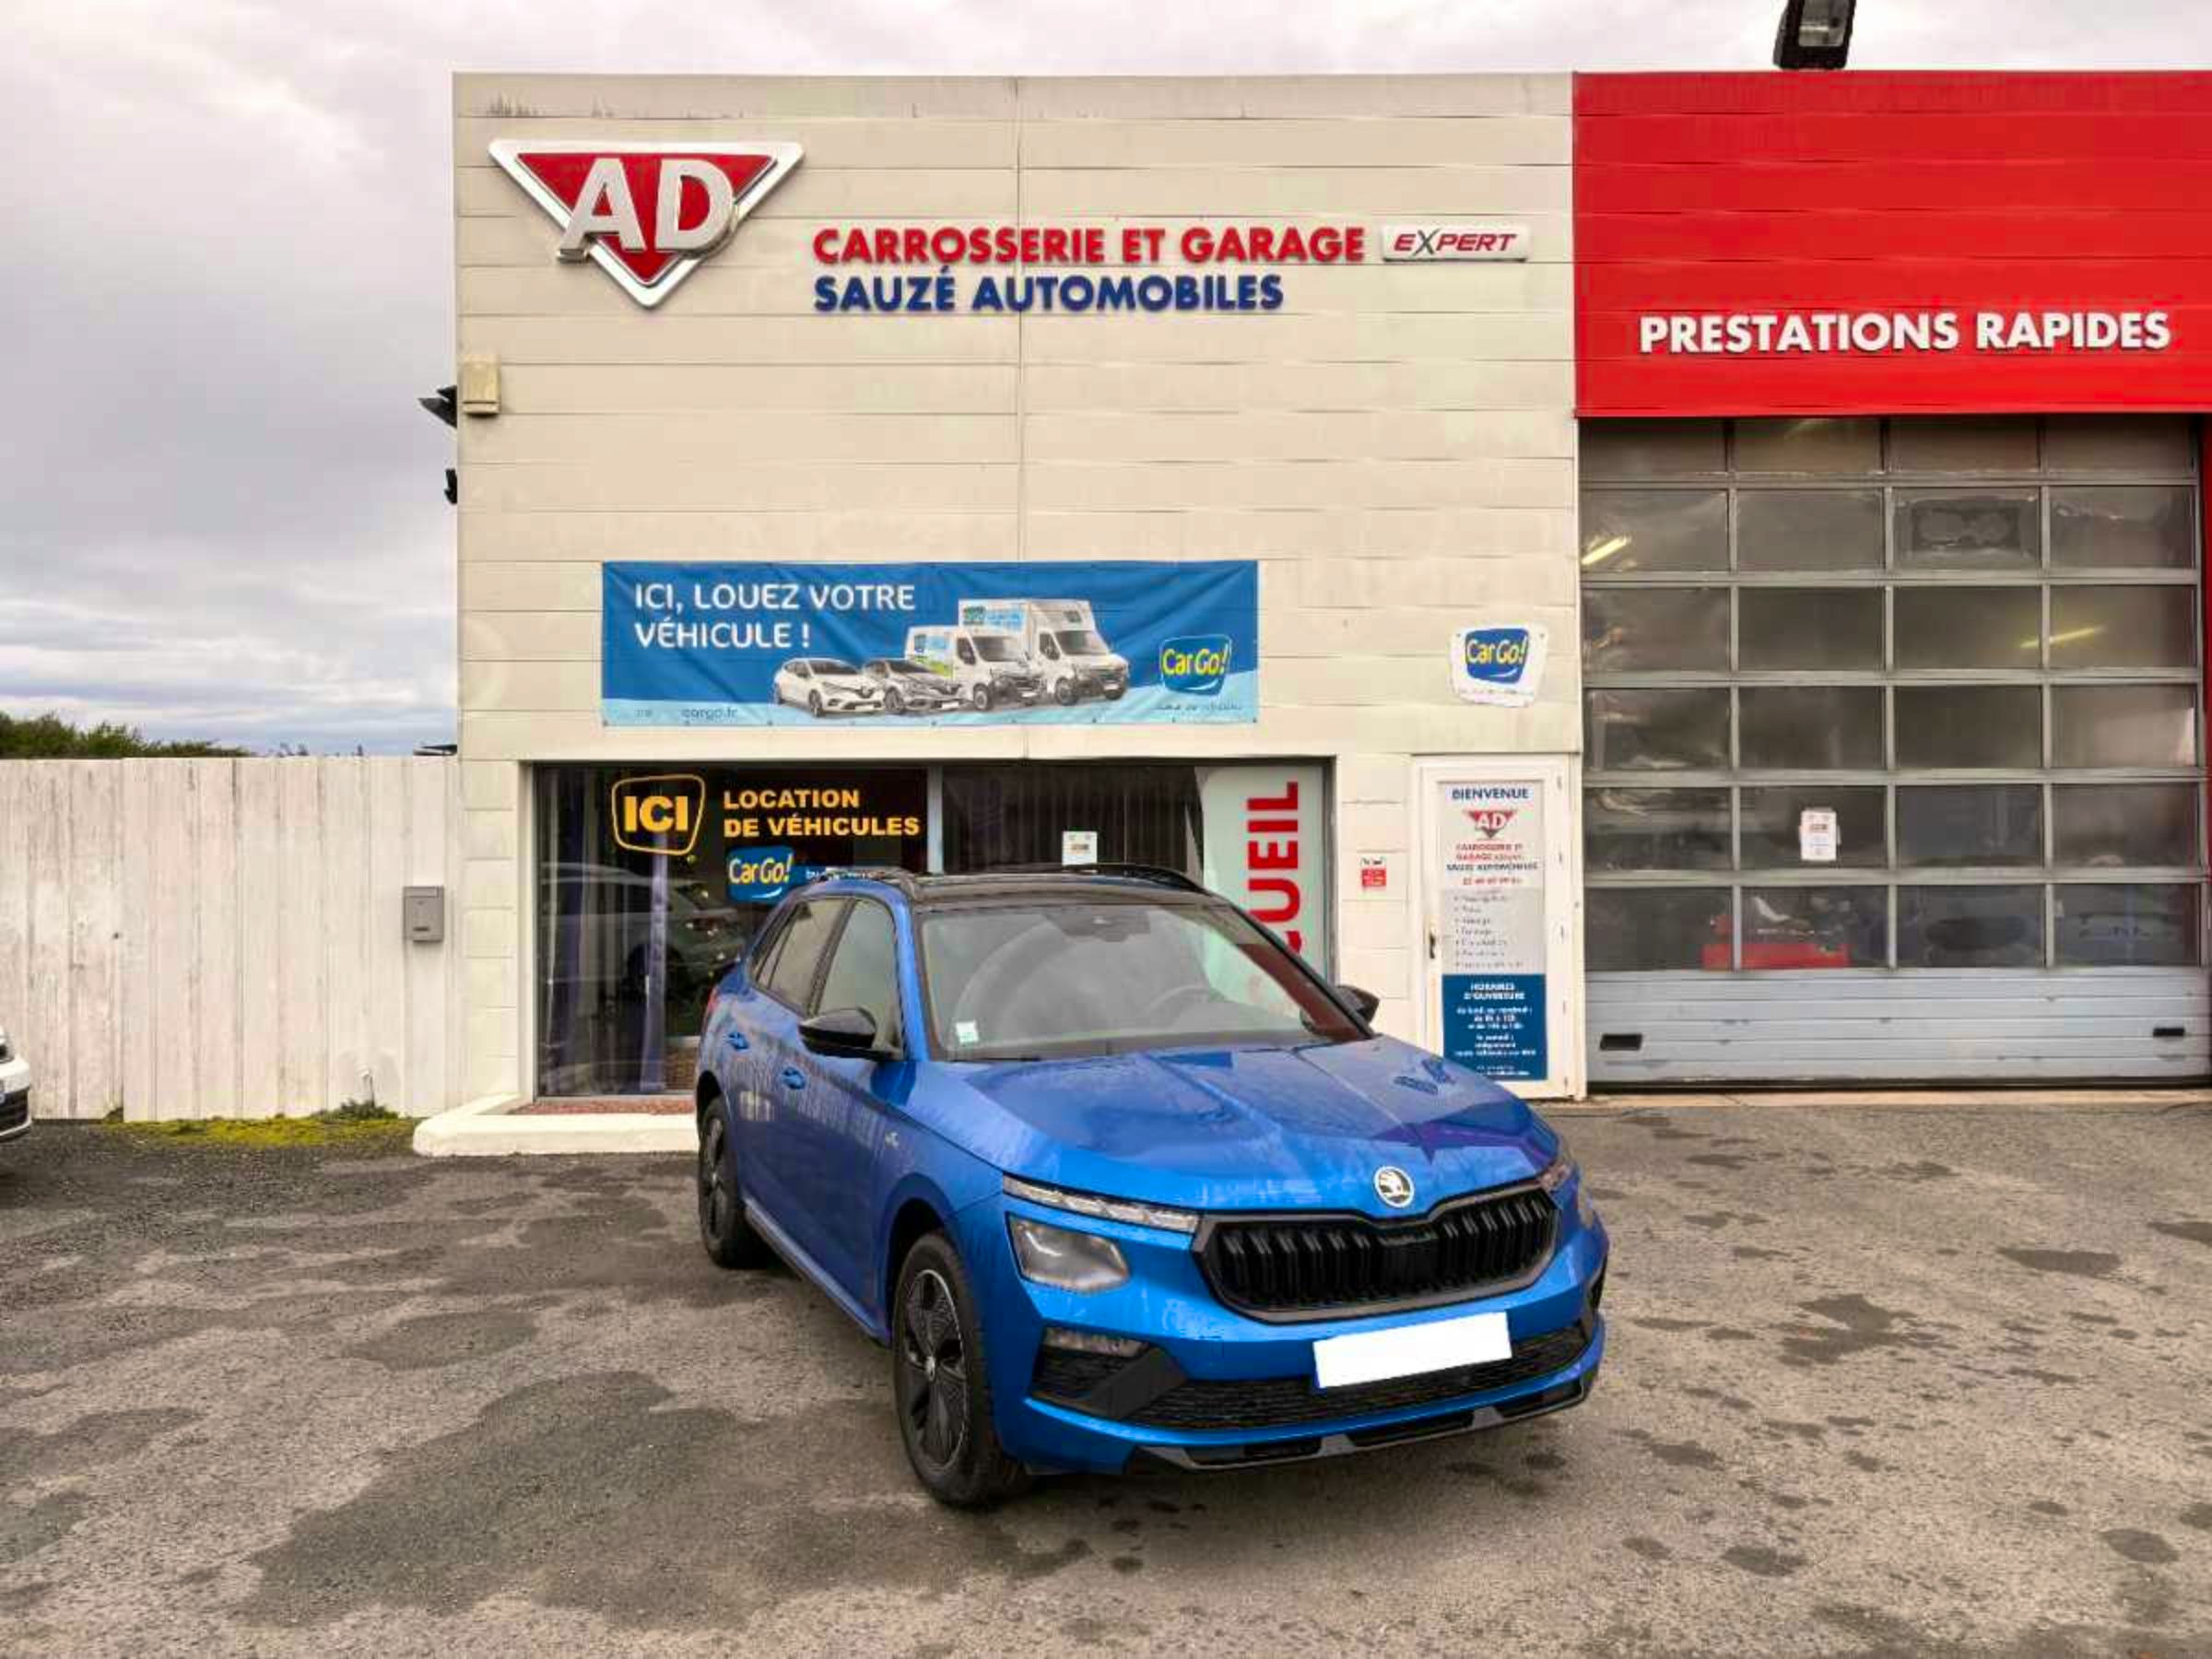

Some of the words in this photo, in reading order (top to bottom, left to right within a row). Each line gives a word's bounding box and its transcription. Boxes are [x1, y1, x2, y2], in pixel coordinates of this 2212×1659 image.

[559, 157, 736, 258] AD
[813, 228, 1105, 265] CARROSSERIE
[1122, 228, 1166, 264] ET
[1181, 227, 1365, 264] GARAGE
[1394, 229, 1517, 256] EXPERT
[814, 265, 956, 312] SAUZÉ
[971, 275, 1285, 312] AUTOMOBILES
[1639, 312, 1960, 353] PRESTATIONS
[1976, 312, 2171, 350] RAPIDES
[635, 583, 684, 615] ICI,
[695, 583, 800, 611] LOUEZ
[809, 583, 915, 611] VOTRE
[635, 617, 792, 648] VÉHICULE
[801, 623, 810, 647] !
[724, 789, 860, 809] LOCATION
[1452, 788, 1530, 800] BIENVENUE
[624, 795, 688, 831] ICI
[724, 818, 759, 838] DE
[768, 814, 920, 837] VÉHICULES
[1246, 781, 1301, 954] UEIL
